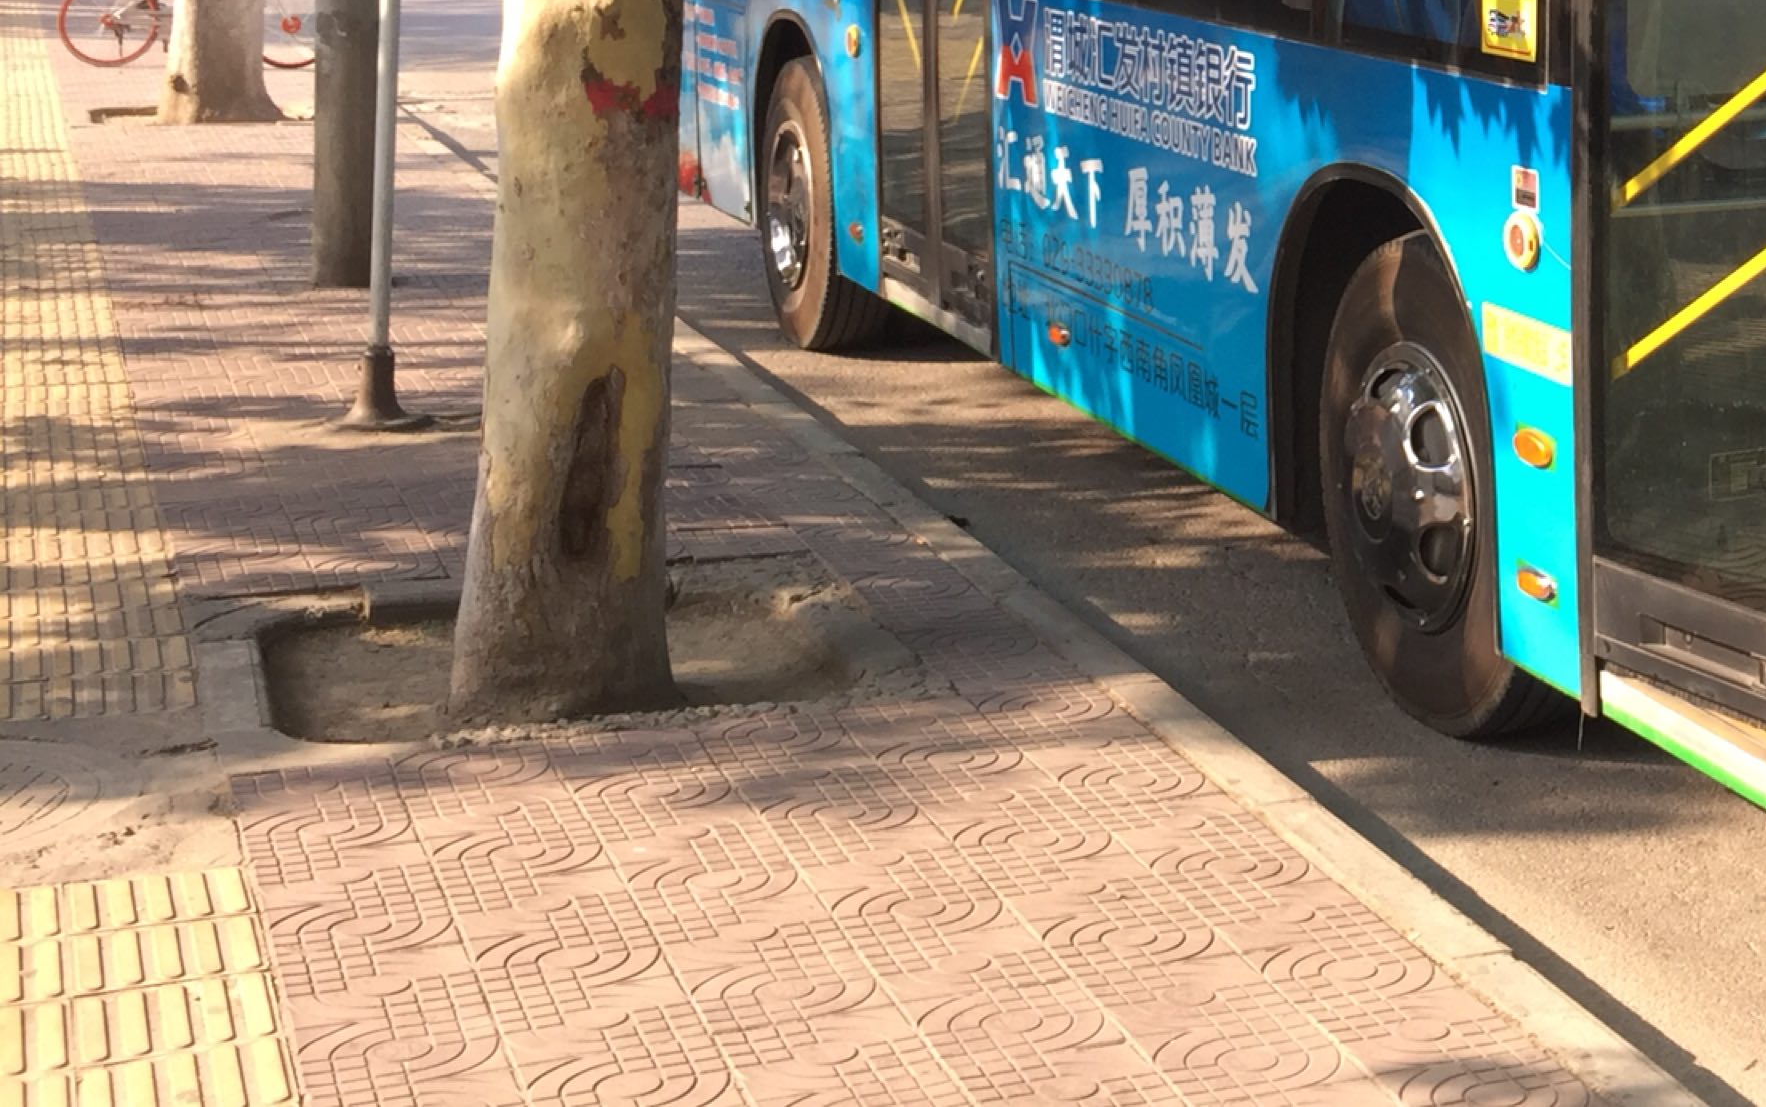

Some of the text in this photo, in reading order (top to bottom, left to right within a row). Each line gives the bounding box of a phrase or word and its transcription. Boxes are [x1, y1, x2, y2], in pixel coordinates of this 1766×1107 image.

[1042, 6, 1257, 131] 渭城汇发村镇银行
[1042, 79, 1258, 177] WEICHENG HUIFA COUNTY BANK
[996, 128, 1260, 295] 汇通天下 厚积薄发
